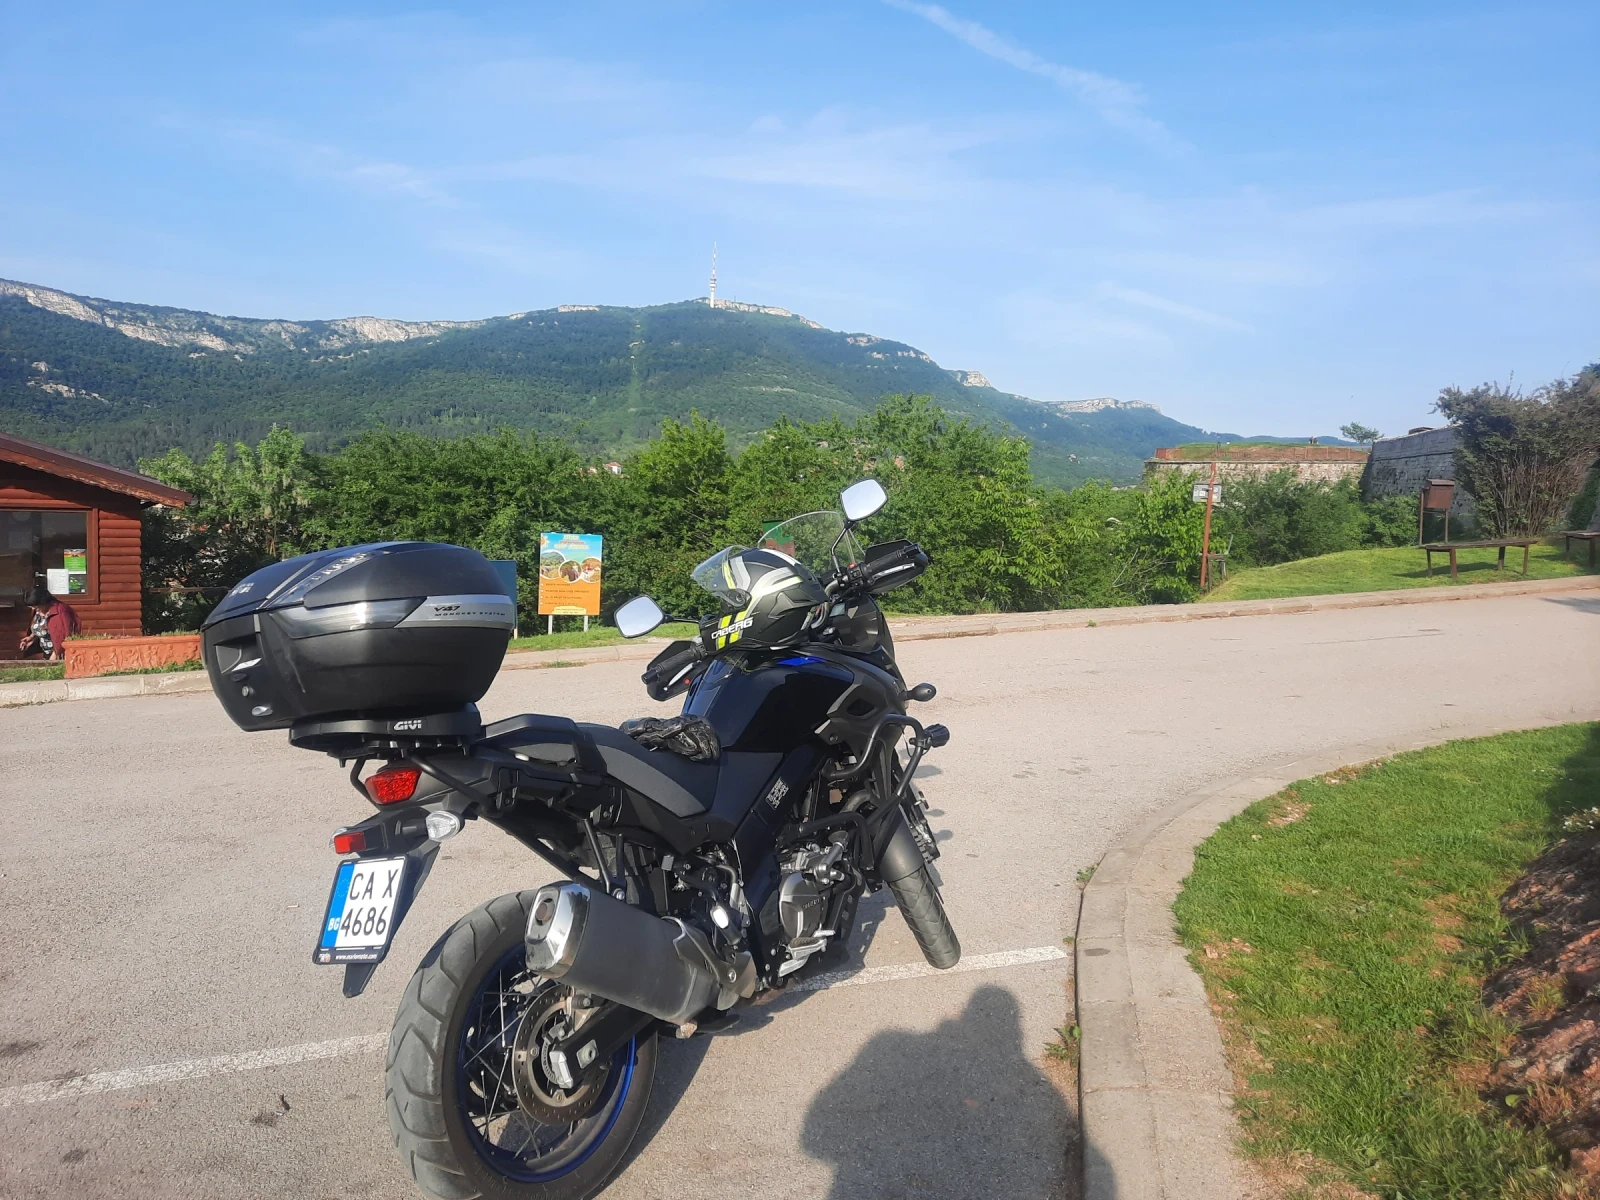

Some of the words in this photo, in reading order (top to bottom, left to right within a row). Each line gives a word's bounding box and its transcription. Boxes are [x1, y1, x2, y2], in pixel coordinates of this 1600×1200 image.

[711, 616, 754, 639] CABERG
[393, 719, 422, 731] GIVI
[349, 871, 375, 900] CA
[381, 868, 399, 899] X
[328, 917, 340, 931] BG
[340, 905, 388, 937] 4686
